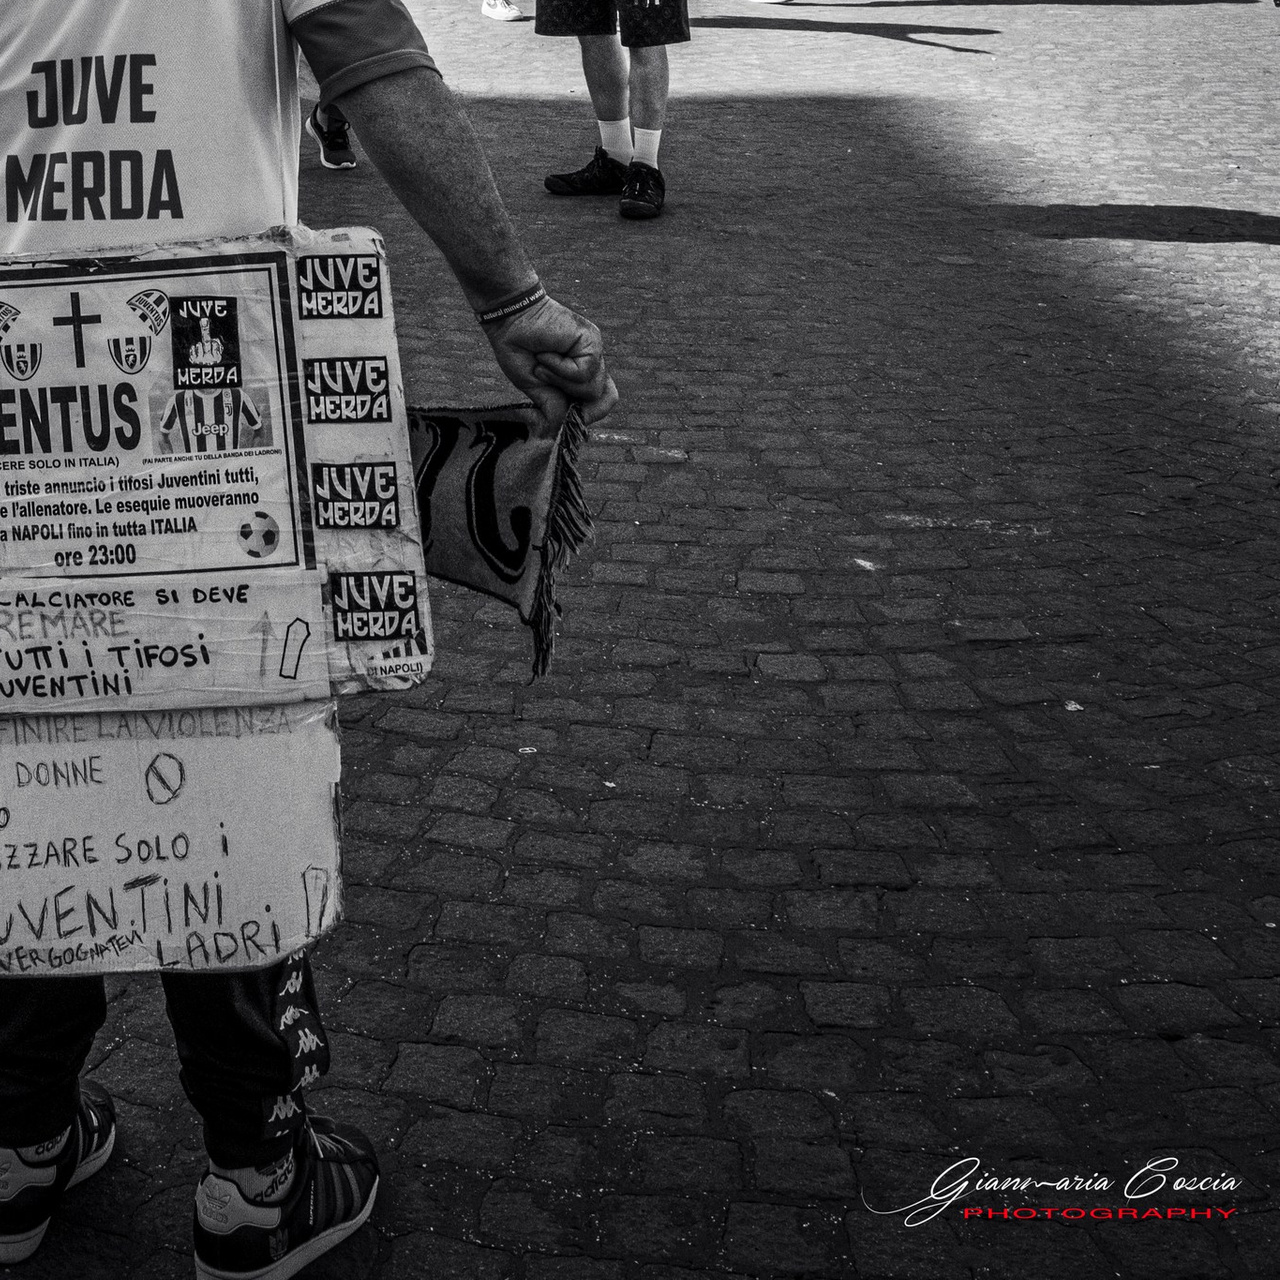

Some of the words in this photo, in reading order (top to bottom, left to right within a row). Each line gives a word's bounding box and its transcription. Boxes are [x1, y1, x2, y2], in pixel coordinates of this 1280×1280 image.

[26, 53, 157, 129] JUVE
[5, 149, 184, 222] MERDA
[300, 257, 378, 290] JUVE
[135, 296, 164, 327] JUVENTUS
[179, 300, 228, 318] JUVE
[302, 291, 378, 316] MERDA
[178, 366, 238, 386] MERDA
[308, 360, 386, 394] JUVE
[310, 394, 388, 420] MERDA
[192, 422, 229, 436] Jeep
[28, 458, 62, 470] SOLO
[64, 458, 76, 468] IN
[79, 456, 120, 468] ITALIA)
[142, 458, 154, 466] (FAI
[154, 456, 173, 464] PARTE
[254, 448, 282, 456] LADRONI)
[4, 480, 40, 496] triste
[44, 476, 106, 494] annuncio
[110, 476, 114, 492] i
[119, 474, 154, 492] tifosi
[157, 469, 221, 489] Juventini
[224, 466, 260, 485] tutti,
[316, 466, 396, 500] JUVE
[0, 506, 8, 518] e
[96, 498, 112, 514] Le
[116, 496, 171, 516] esequie
[175, 492, 260, 510] muoveranno
[318, 501, 397, 526] MERDA
[12, 523, 64, 542] NAPOLI
[68, 522, 92, 540] fino
[96, 522, 108, 538] in
[112, 520, 146, 536] tutta
[150, 516, 198, 534] ITALIA
[54, 550, 83, 568] ore
[88, 544, 136, 566] 23:00
[155, 588, 180, 606] SI
[192, 584, 250, 605] DEVE
[334, 575, 415, 610] JUVE
[337, 610, 416, 638] MERDA
[380, 662, 423, 676] NAPOLI)
[97, 714, 133, 740] LA
[139, 708, 292, 738] VIOLENZA
[16, 755, 106, 788] DONNE
[115, 831, 191, 866] SOLO
